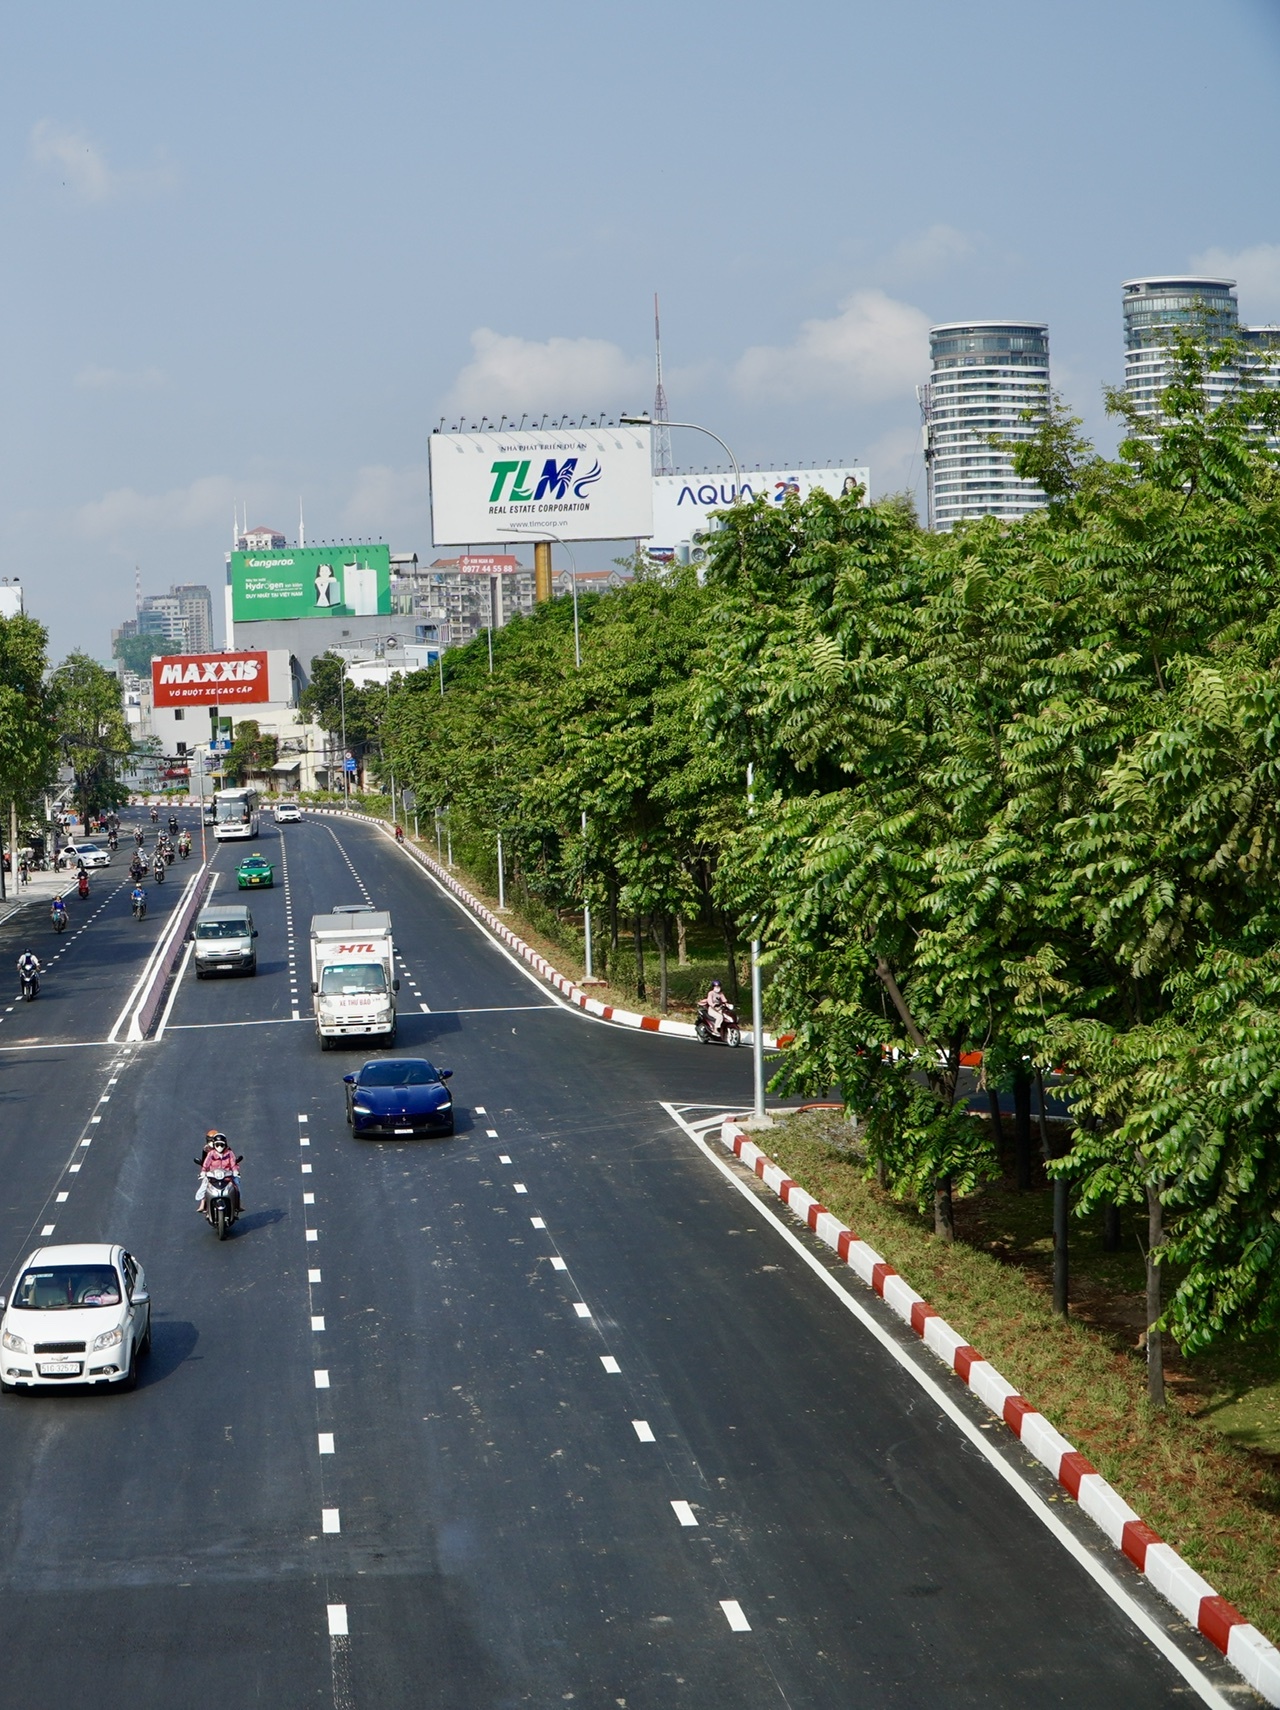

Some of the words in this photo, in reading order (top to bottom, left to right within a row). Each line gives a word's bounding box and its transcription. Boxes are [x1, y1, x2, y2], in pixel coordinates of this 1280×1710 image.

[489, 506, 507, 514] REAL
[510, 505, 536, 514] ESTATE
[538, 503, 590, 513] CORPORATION
[510, 520, 568, 528] www.tlmcorp.vn
[160, 660, 258, 684] MAXXIS
[205, 688, 217, 696] XE
[217, 687, 234, 695] CAO
[338, 943, 375, 954] HTL
